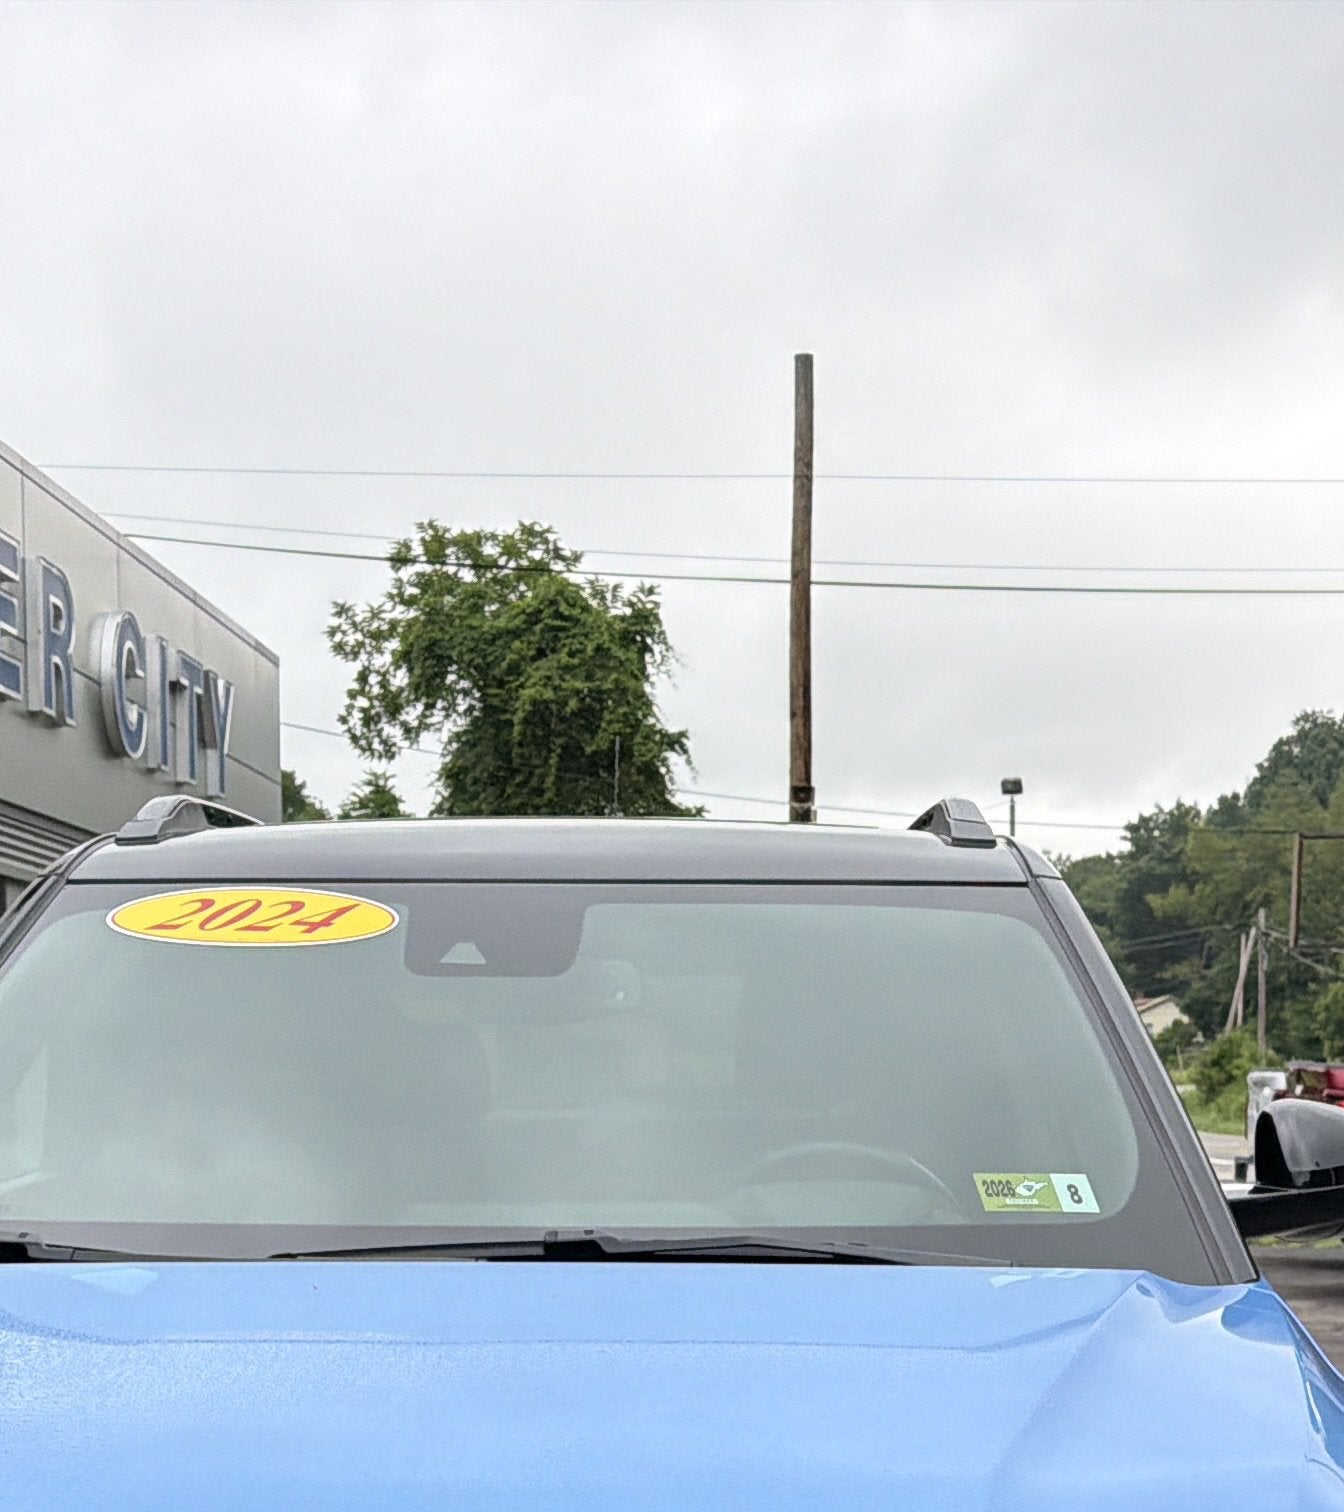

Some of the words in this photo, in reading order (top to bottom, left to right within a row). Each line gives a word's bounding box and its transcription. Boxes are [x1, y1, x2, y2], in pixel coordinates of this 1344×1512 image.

[93, 609, 236, 797] CITY
[143, 897, 361, 934] 2024
[982, 1179, 1016, 1198] 2026
[1066, 1183, 1083, 1205] 8
